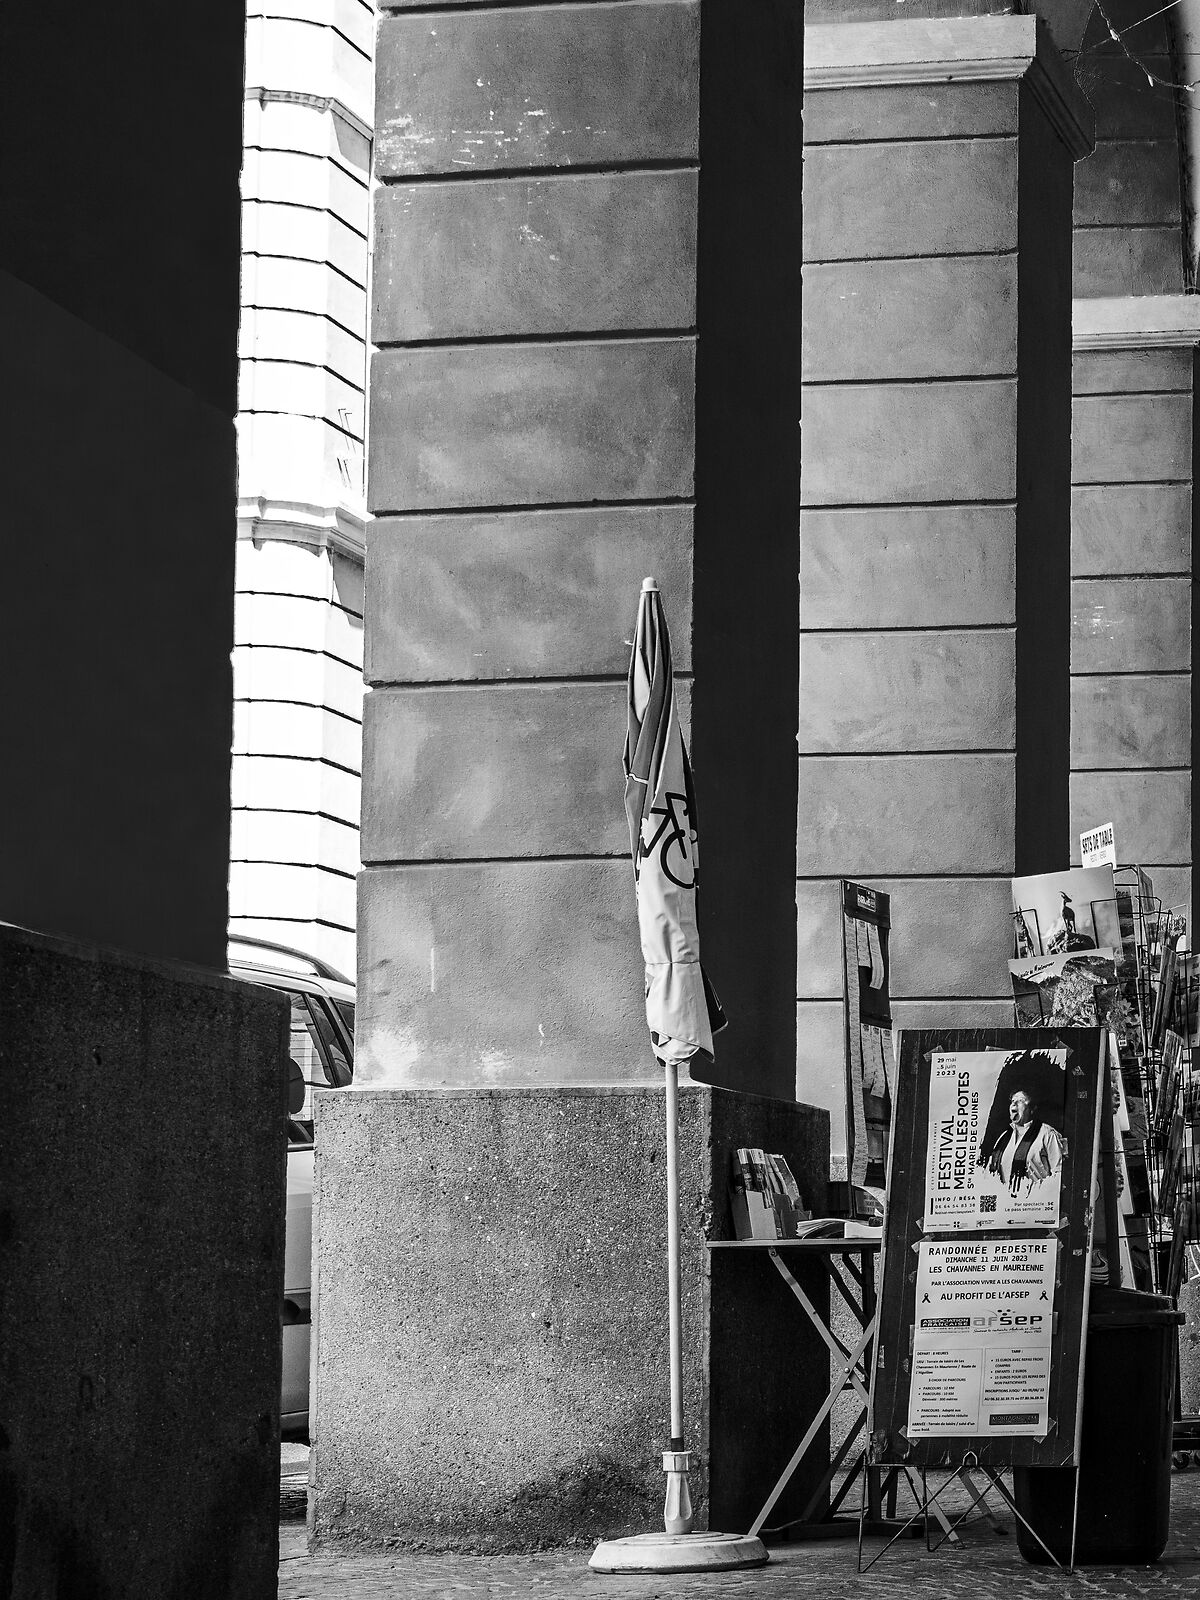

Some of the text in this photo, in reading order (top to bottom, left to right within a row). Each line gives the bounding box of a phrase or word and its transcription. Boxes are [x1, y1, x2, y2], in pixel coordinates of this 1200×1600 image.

[970, 1091, 979, 1127] CUINES
[953, 1071, 970, 1190] MERCI LES POTES
[969, 1129, 978, 1143] DE
[937, 1115, 955, 1190] FESTIVAL
[968, 1145, 977, 1175] MARIE
[928, 1244, 1048, 1256] RANDONNÉE PEDESTRE
[945, 1256, 978, 1264] DIMANCHE
[992, 1255, 1009, 1263] JUIN
[929, 1264, 1045, 1274] LES CHAVANNES EN MAURIENNE
[940, 1293, 953, 1301] AU
[954, 1292, 984, 1300] PROFIT
[998, 1291, 1030, 1299] L'AFSEP
[973, 1315, 1043, 1327] afsep
